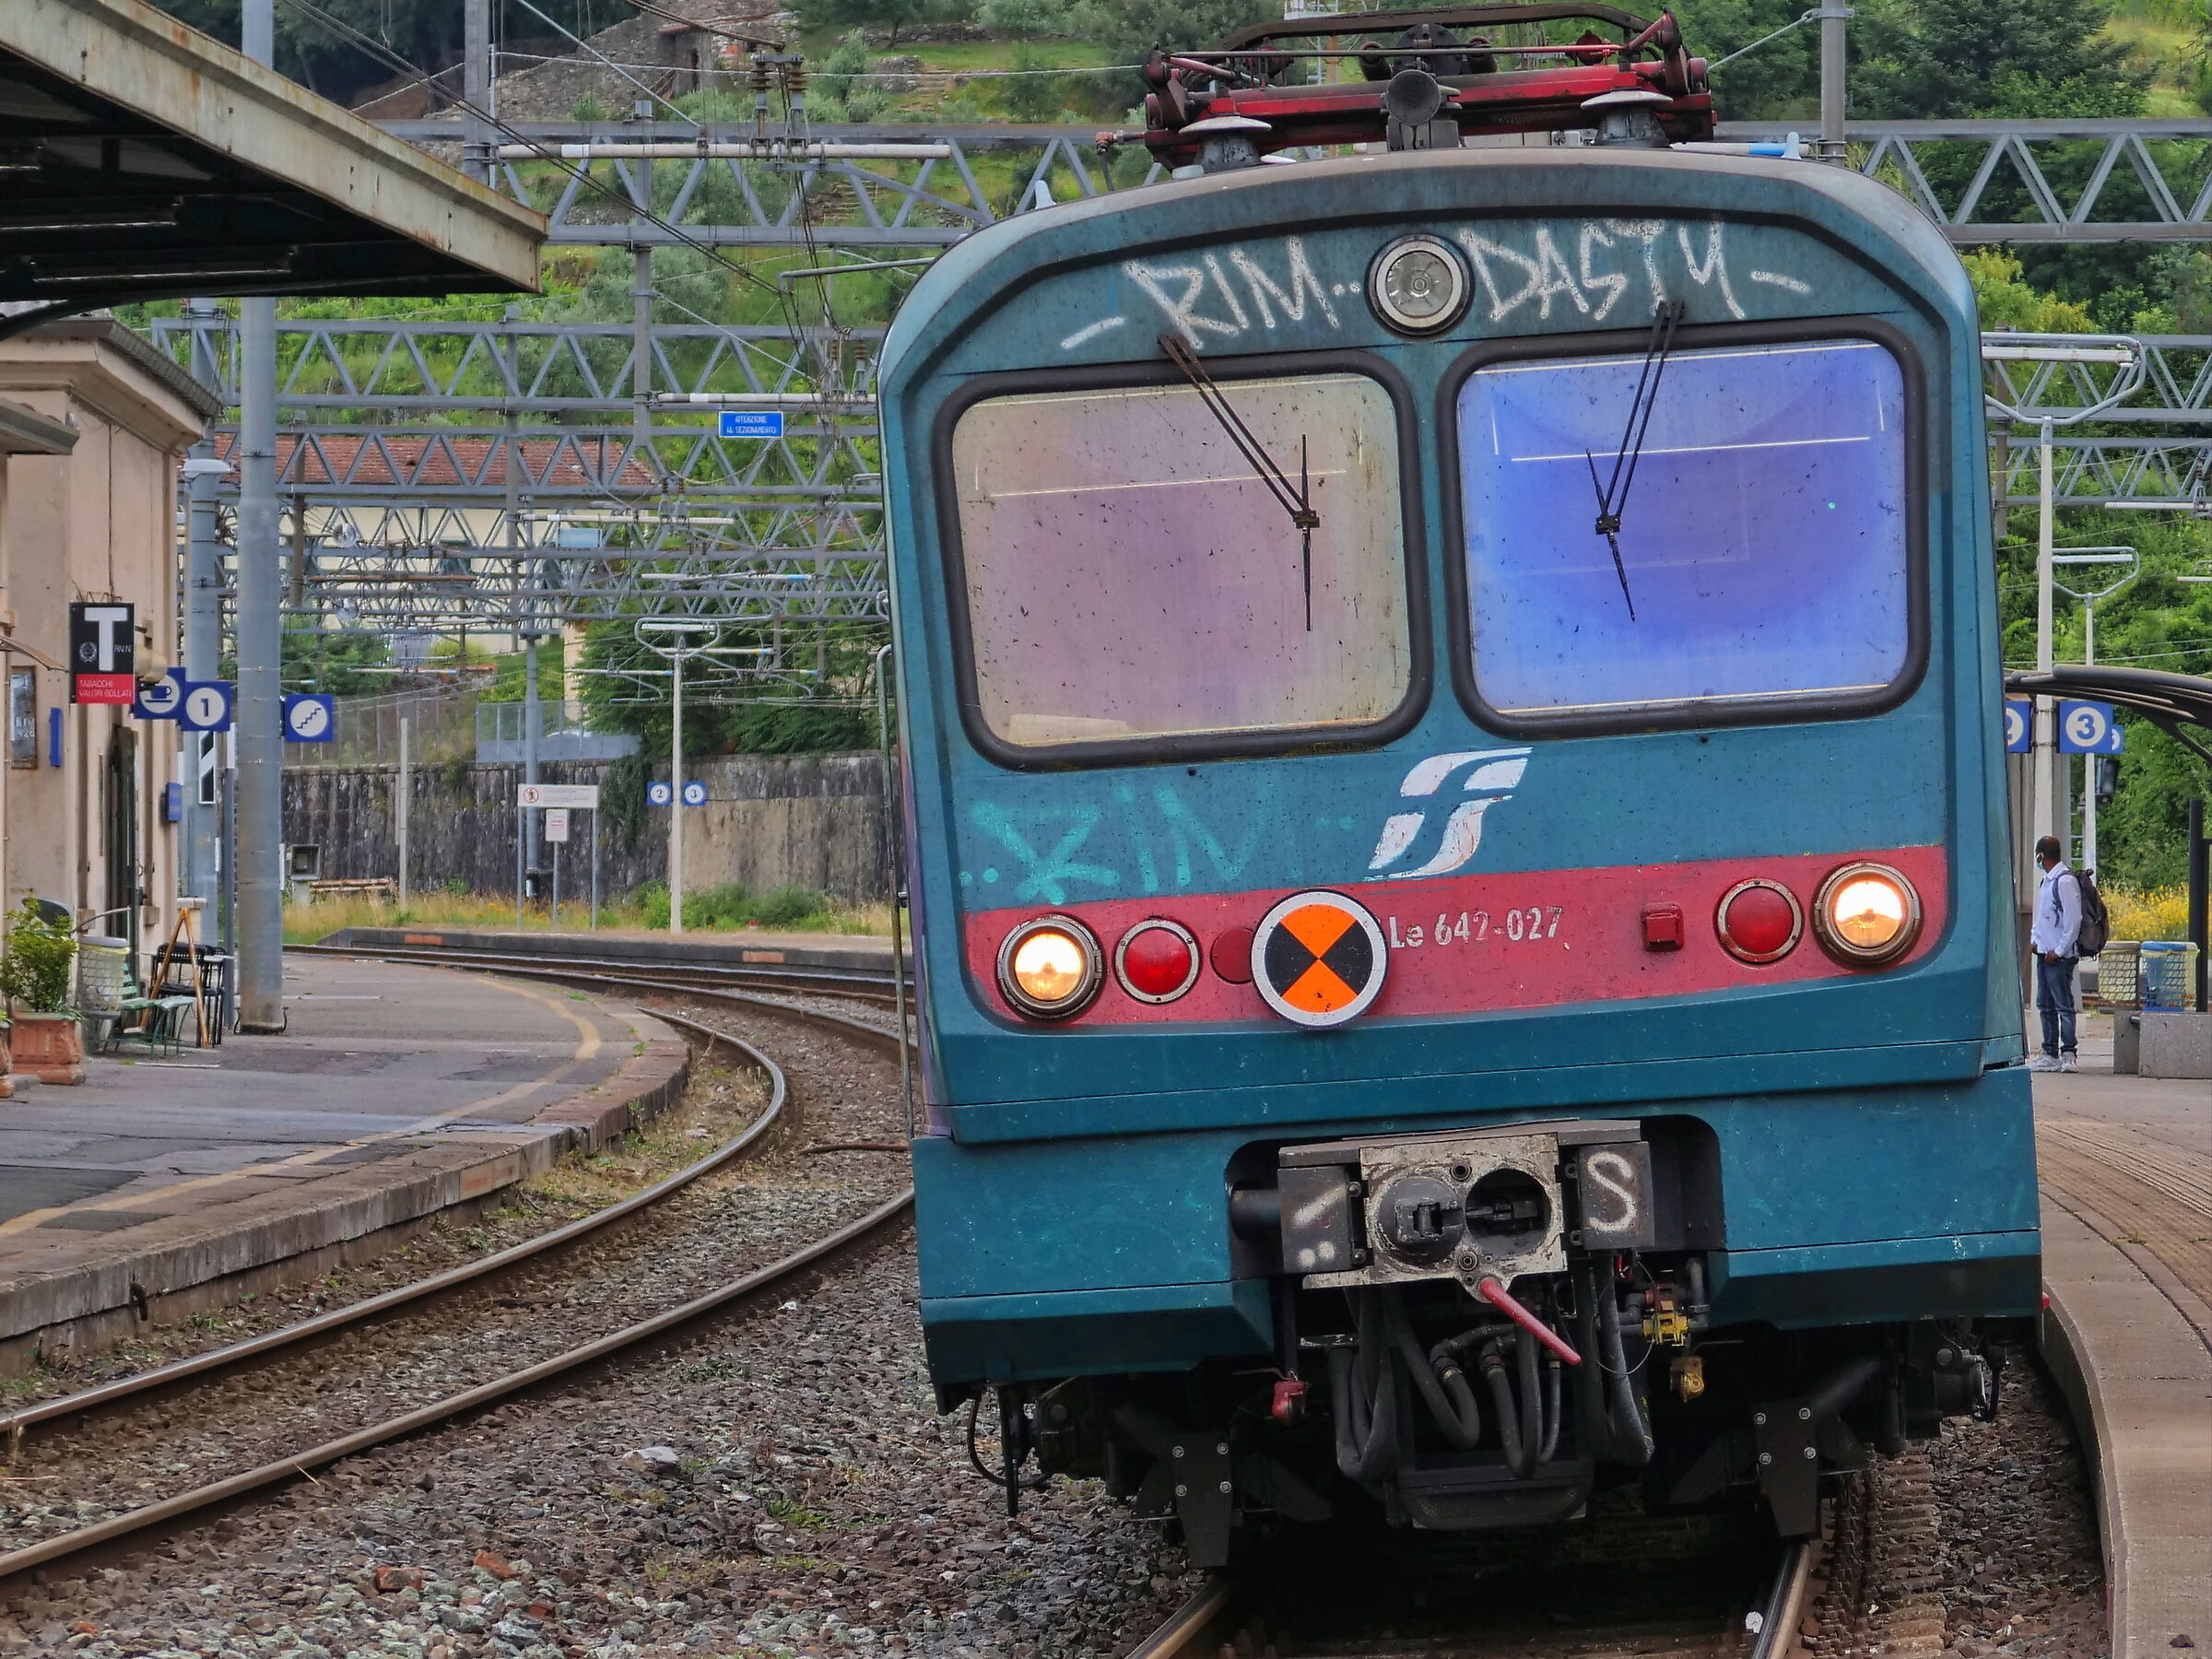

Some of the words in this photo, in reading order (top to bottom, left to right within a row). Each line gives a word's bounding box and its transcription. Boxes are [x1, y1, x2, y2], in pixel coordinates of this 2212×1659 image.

[84, 607, 127, 671] T
[200, 698, 209, 717] 1
[2076, 713, 2096, 740] 3
